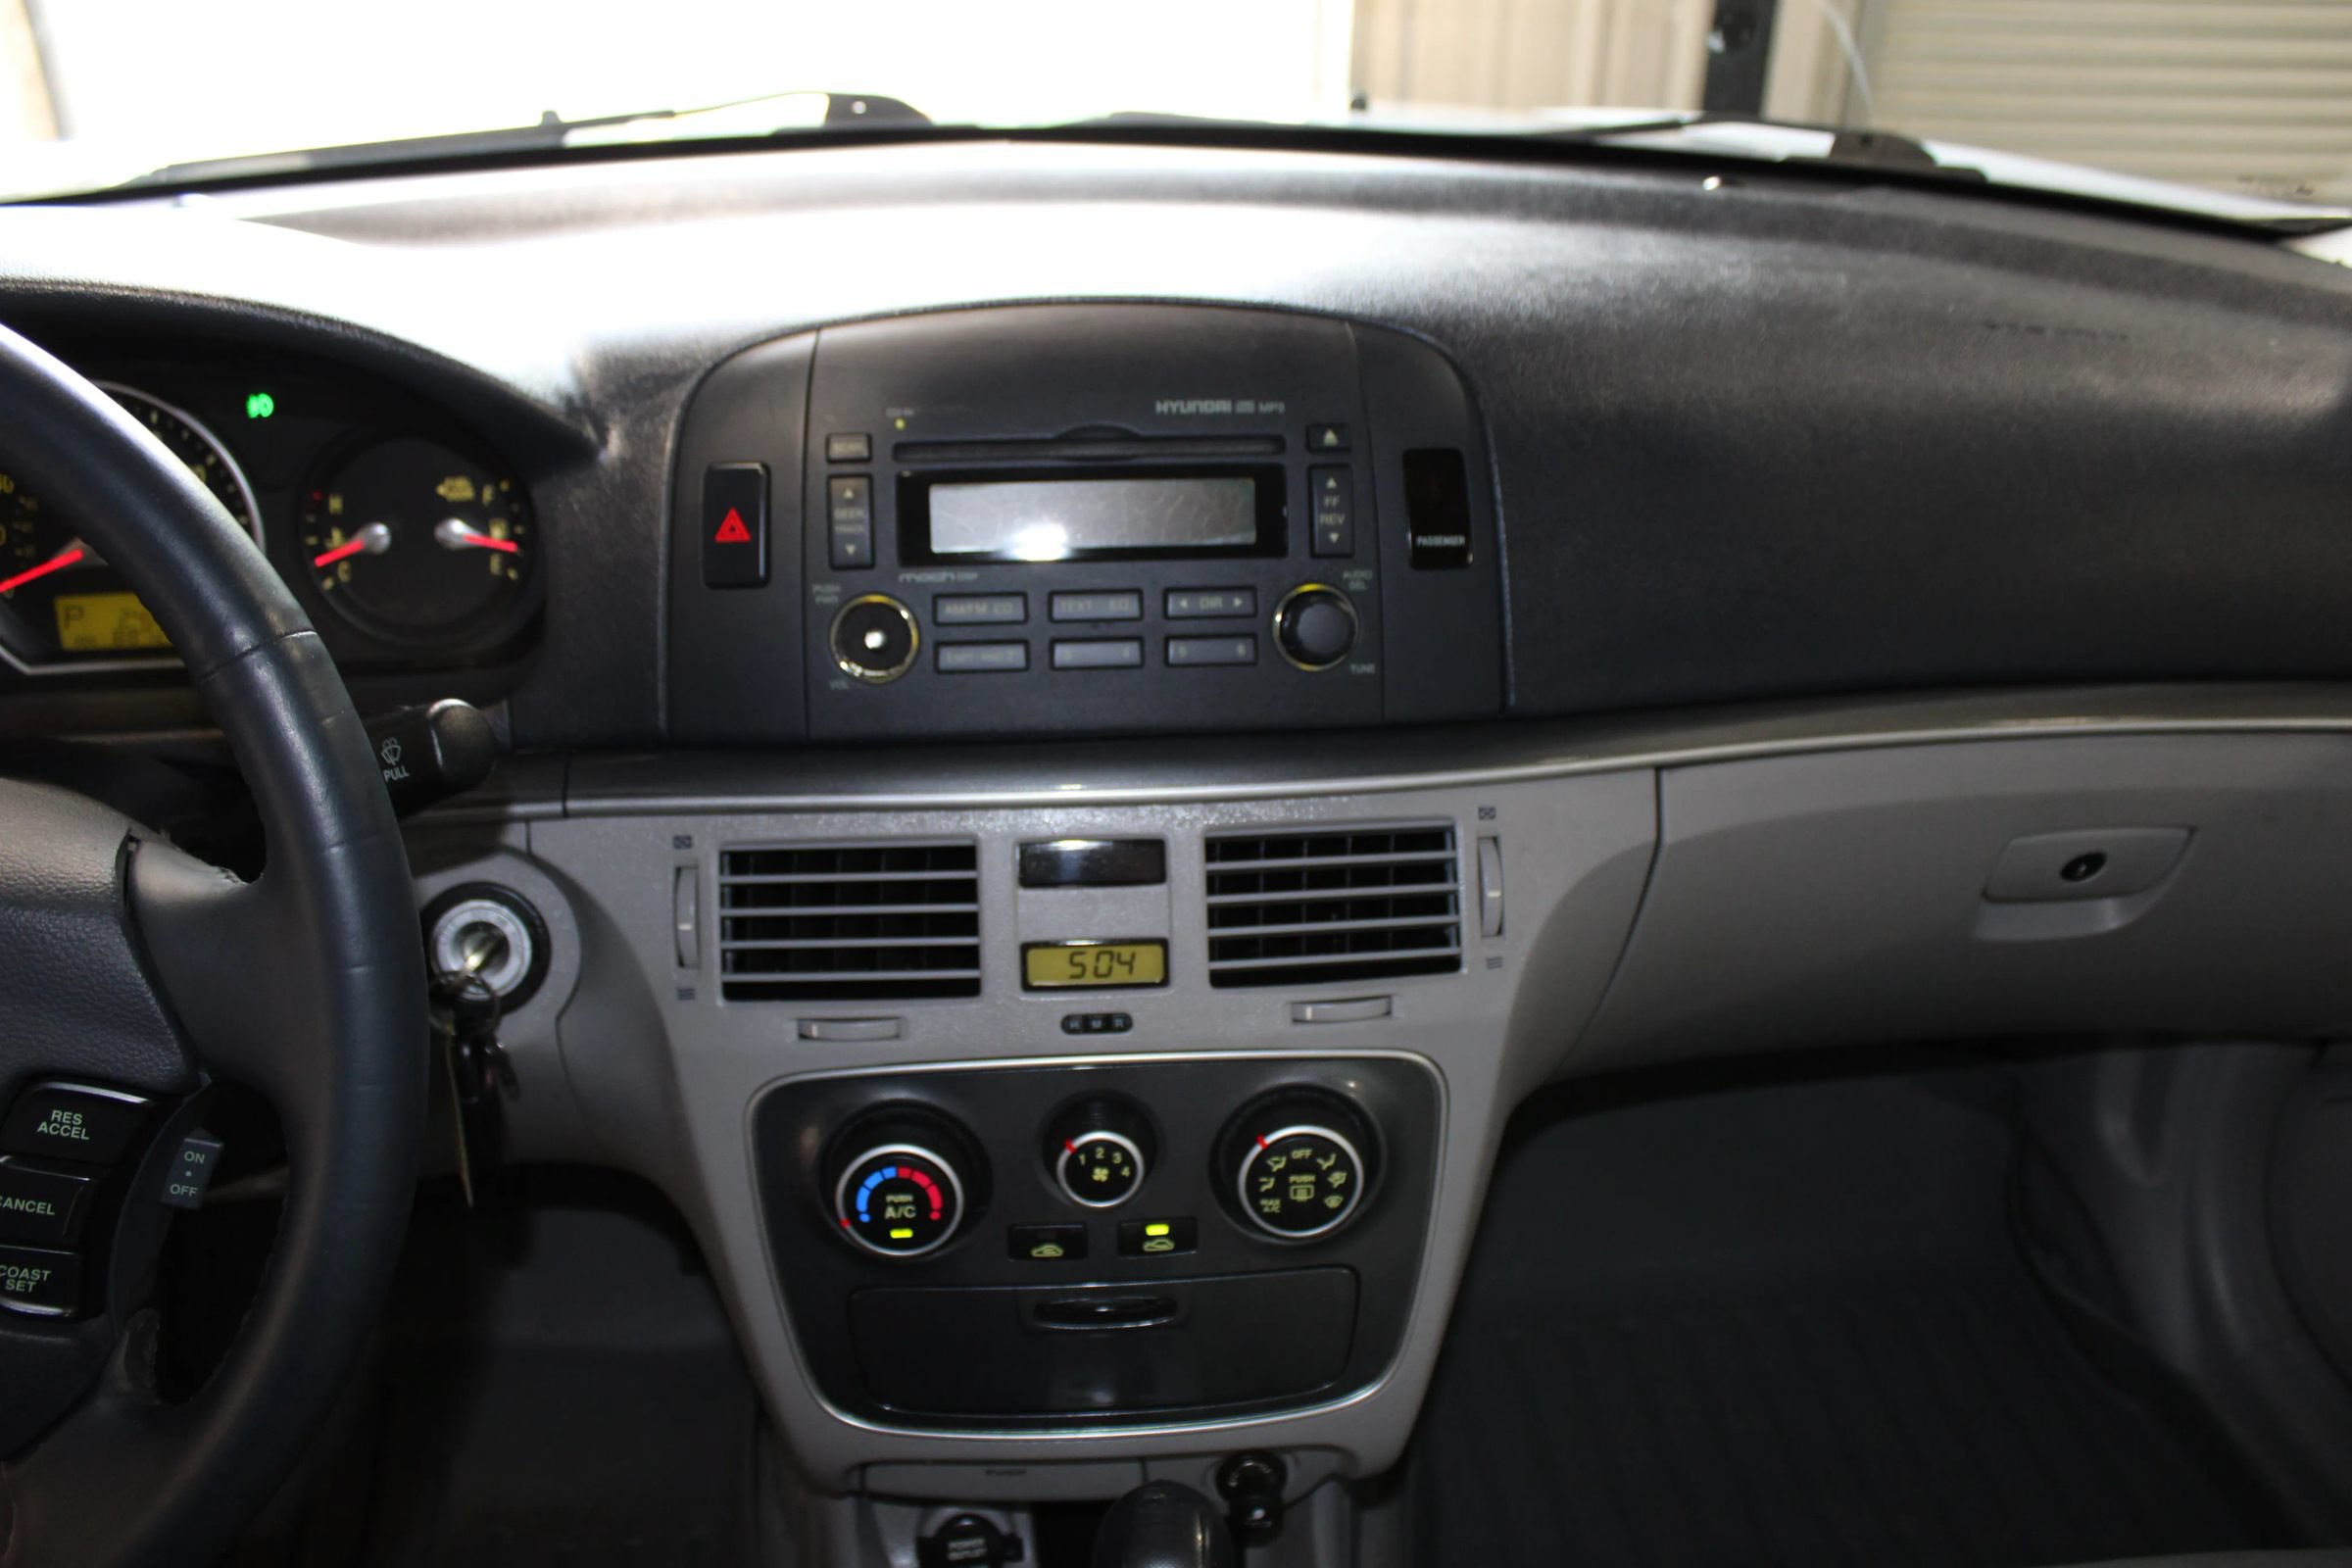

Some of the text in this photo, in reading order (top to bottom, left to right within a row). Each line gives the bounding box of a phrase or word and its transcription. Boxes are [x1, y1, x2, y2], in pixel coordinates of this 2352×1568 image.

[1155, 399, 1232, 415] HYUNDAI
[1324, 495, 1340, 508] FF
[1319, 513, 1346, 525] REV
[383, 765, 410, 782] PULL
[51, 1109, 82, 1125] RES
[36, 1121, 89, 1140] ACCEL
[183, 1150, 206, 1164] ON
[1080, 1147, 1131, 1178] 1 2 3 4
[170, 1183, 198, 1198] OFF
[0, 1195, 56, 1216] ANCEL
[884, 1204, 917, 1220] A/C
[0, 1264, 52, 1282] COAST
[5, 1278, 37, 1293] SET
